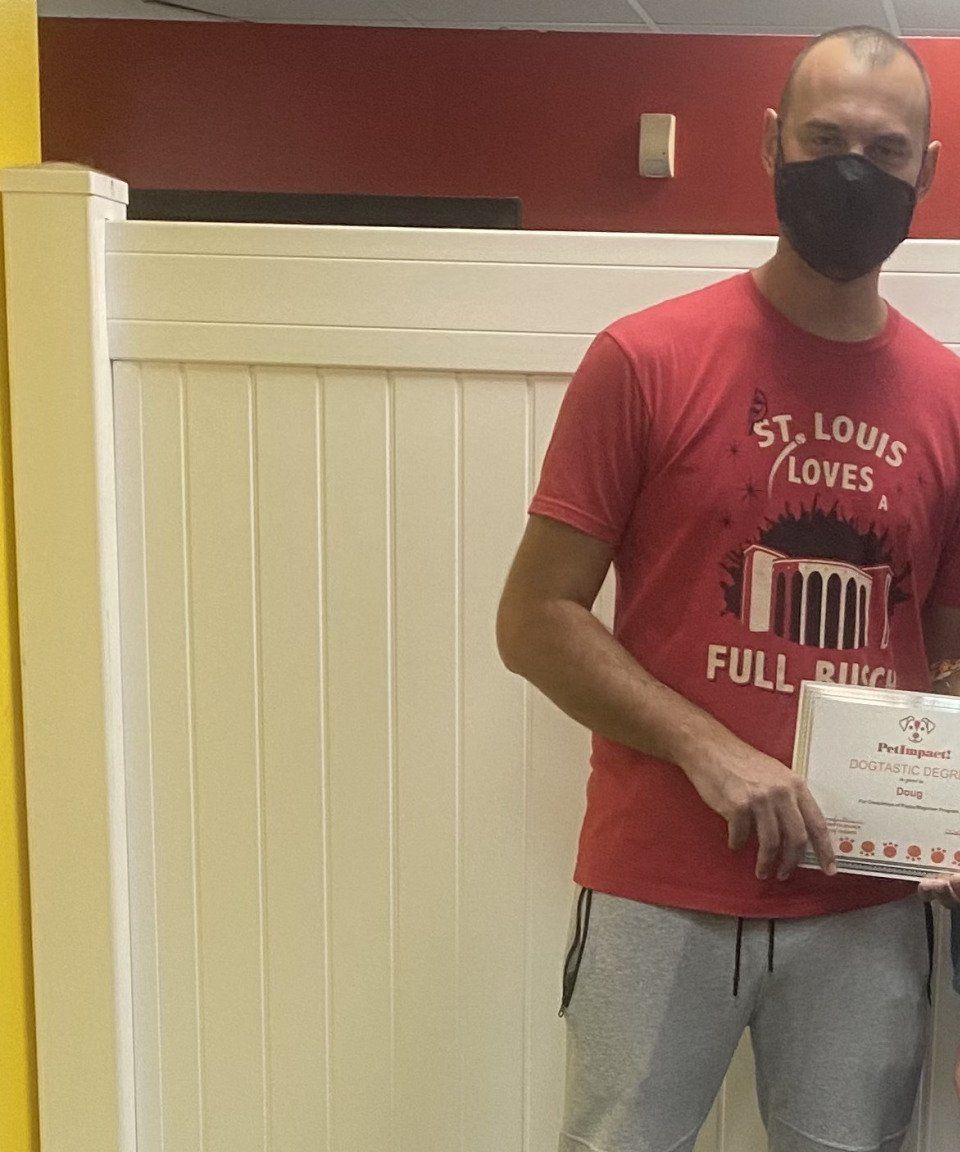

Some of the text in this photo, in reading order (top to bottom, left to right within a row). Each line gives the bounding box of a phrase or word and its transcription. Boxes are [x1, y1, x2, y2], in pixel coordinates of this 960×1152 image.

[753, 411, 908, 468] ST. LOUIS
[788, 455, 874, 493] LOVES
[877, 494, 888, 511] A
[706, 644, 897, 694] FULL BUSCH
[849, 758, 920, 776] DOGTASTIC
[896, 786, 923, 800] Doug
